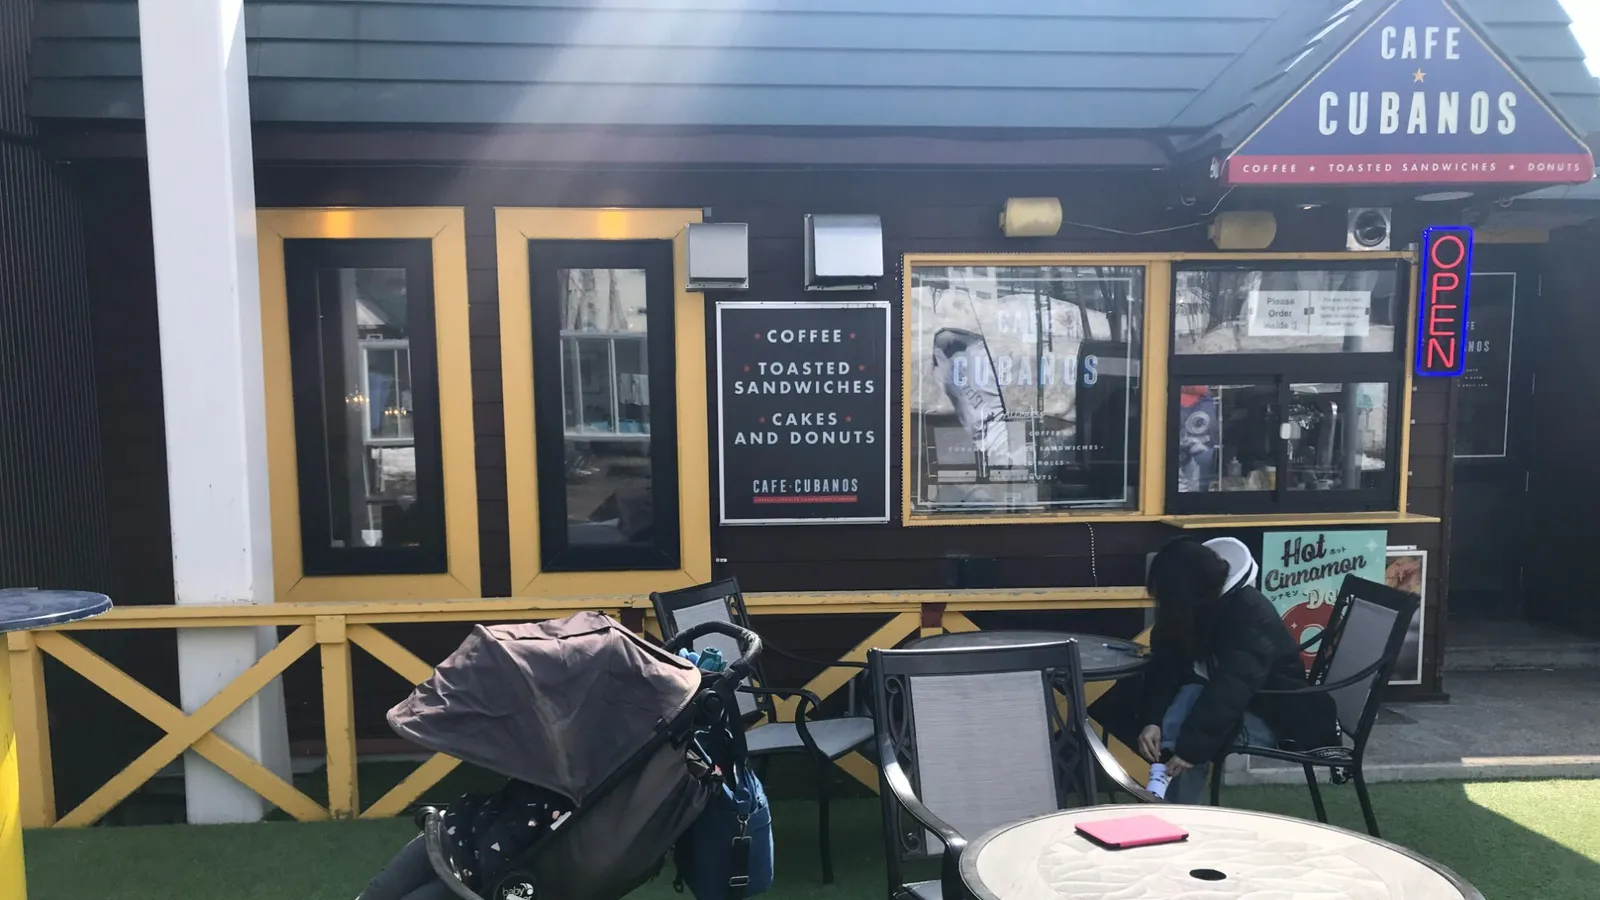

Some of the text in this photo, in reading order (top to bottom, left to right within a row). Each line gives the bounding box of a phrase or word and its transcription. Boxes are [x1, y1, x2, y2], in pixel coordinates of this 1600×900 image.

[1381, 26, 1461, 60] CAFE
[1318, 91, 1518, 135] CUBANOS
[1242, 162, 1580, 173] COFFEE TOASTED SANDWICHES DONUTS
[1266, 297, 1295, 305] Please
[1427, 235, 1465, 368] OPEN
[1268, 309, 1292, 318] Order
[1263, 321, 1289, 330] inside
[766, 329, 842, 344] COFFEE
[758, 361, 851, 376] TOASTED
[952, 354, 1099, 387] CUBANOS
[734, 380, 875, 395] SANDWICHES
[772, 412, 838, 427] CAKES
[734, 430, 875, 445] AND DONUTS
[1039, 445, 1099, 453] SANDWICHES
[753, 478, 858, 493] CAFE CUBANOS
[1281, 533, 1327, 567] Hot
[1329, 546, 1347, 555] ホット
[1265, 555, 1367, 592] Cinnamon
[1270, 589, 1299, 602] シナモン
[502, 886, 525, 897] baby
